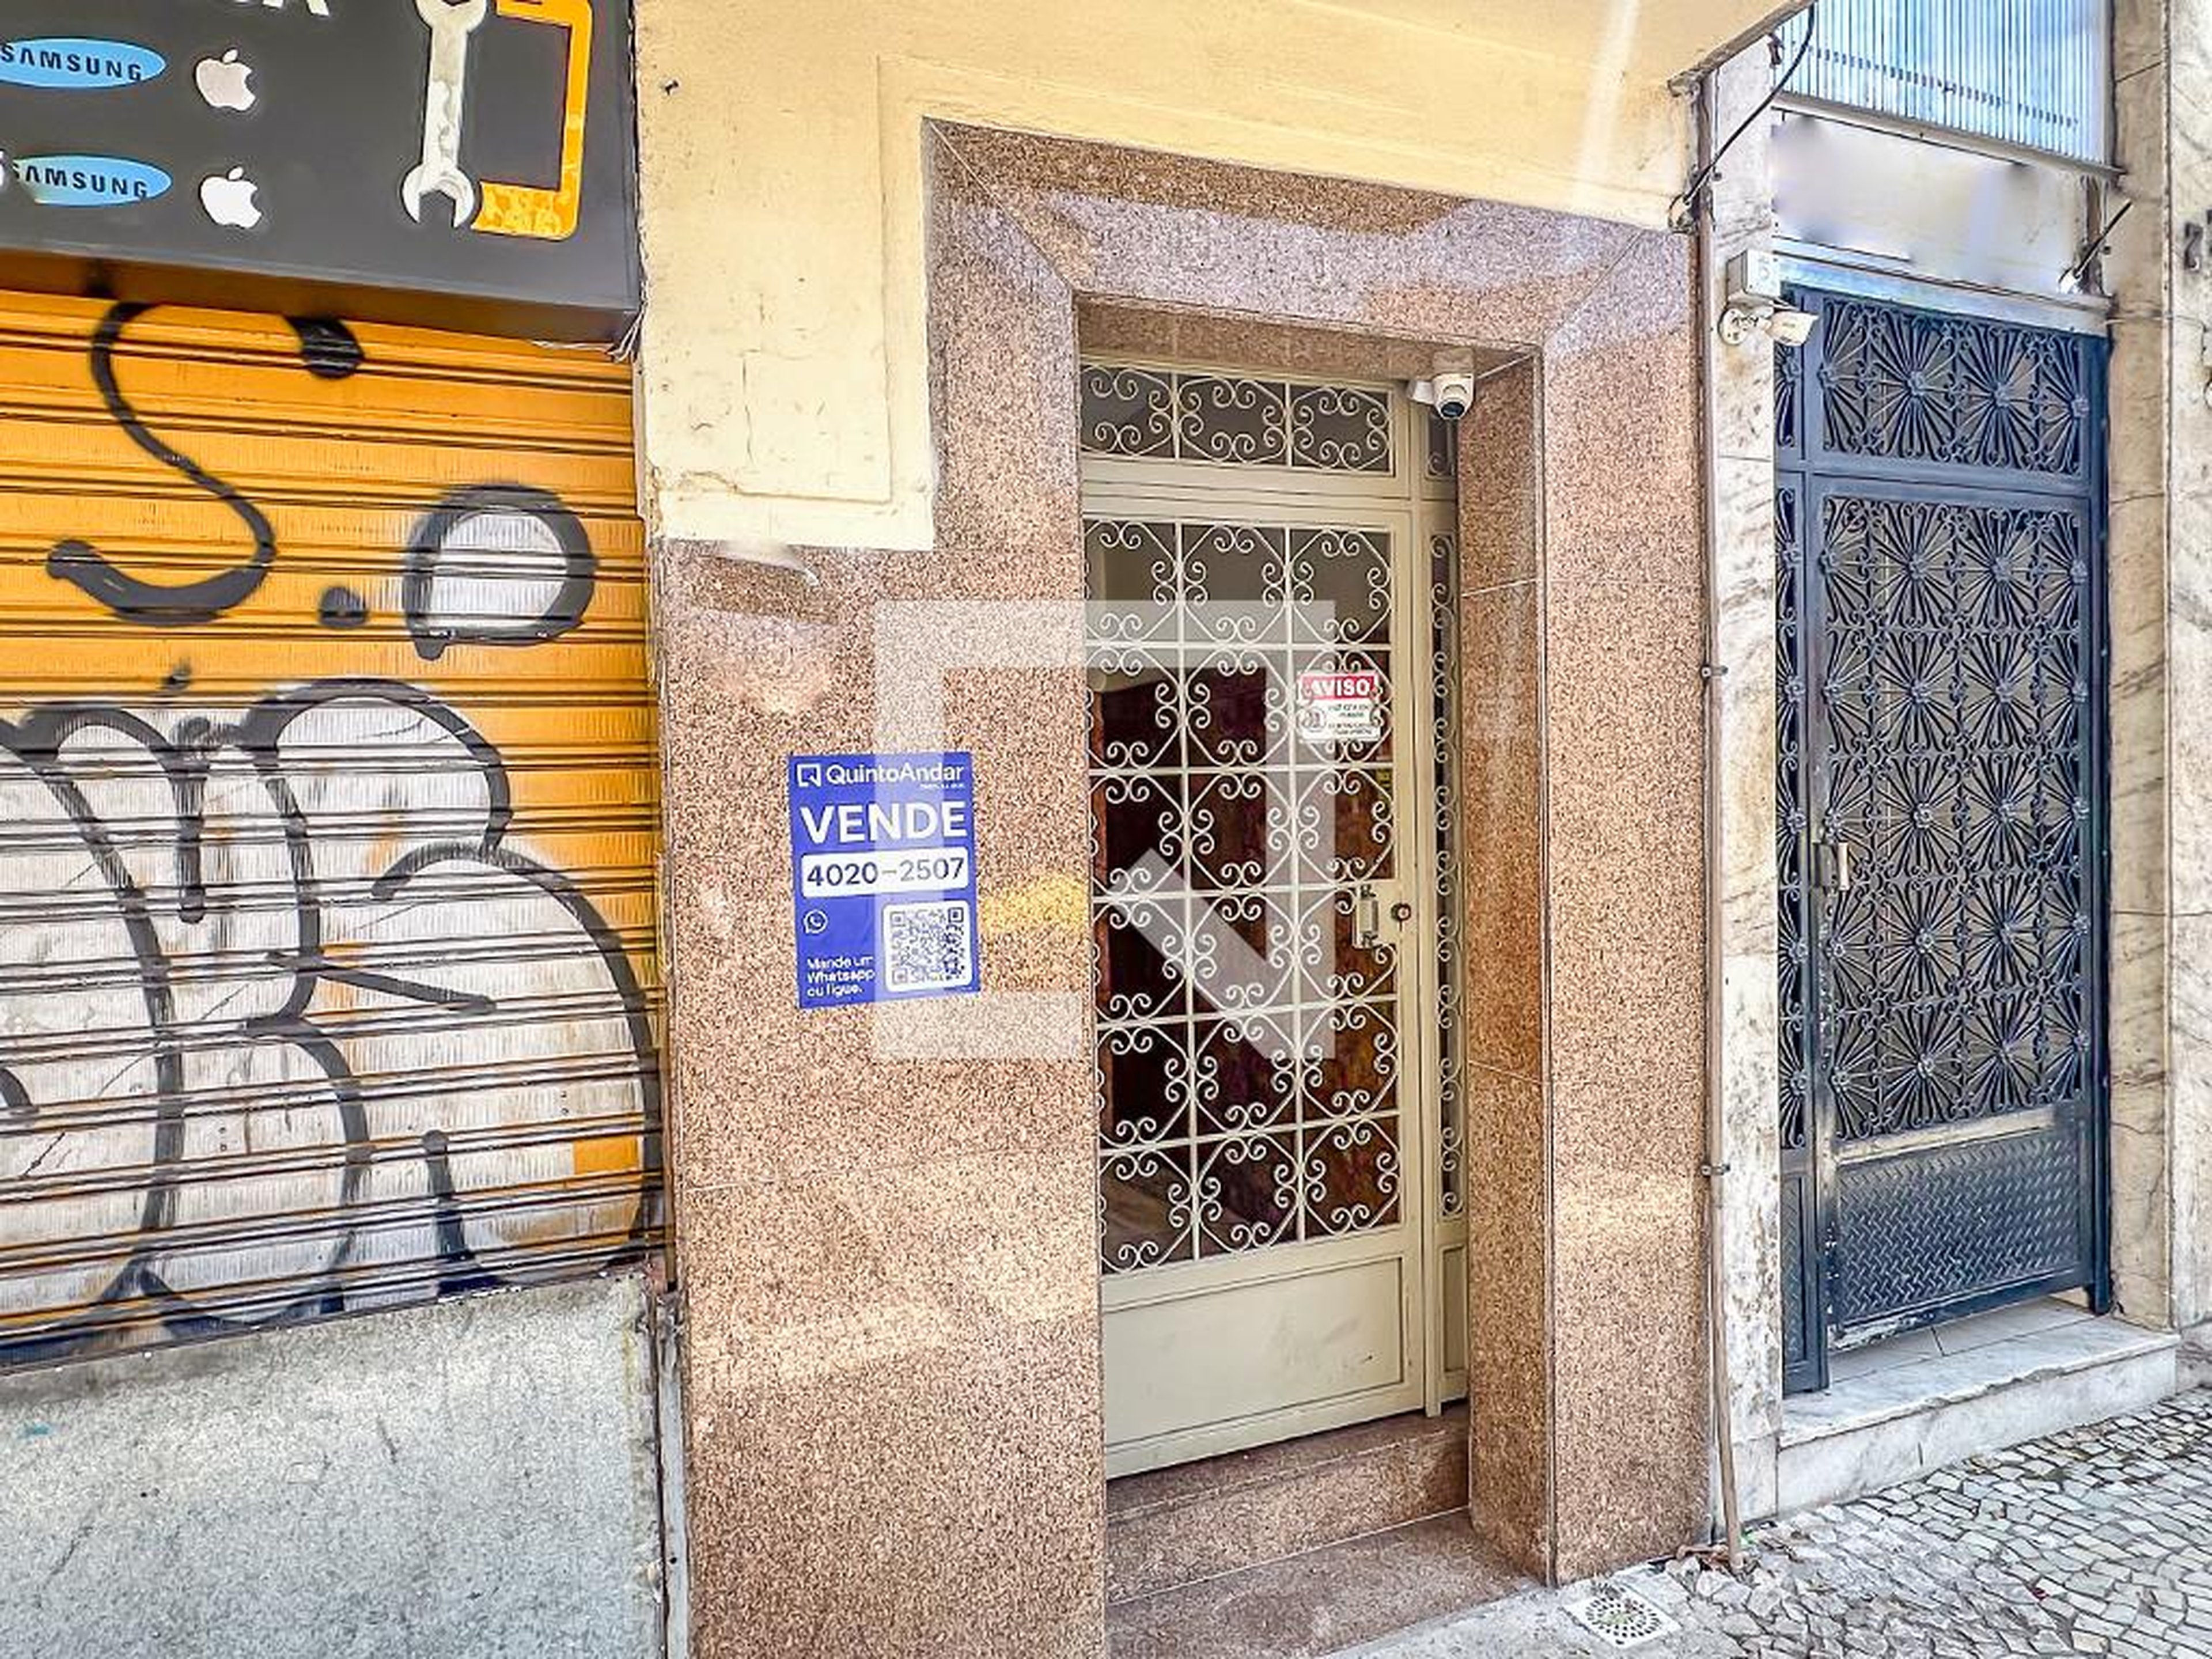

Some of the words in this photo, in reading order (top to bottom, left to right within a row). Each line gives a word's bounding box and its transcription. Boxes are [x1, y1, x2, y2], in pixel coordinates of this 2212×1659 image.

[0, 44, 141, 81] SAMSUNG
[1310, 678, 1370, 697] AVISO
[826, 762, 964, 785] QuintoAndar
[800, 801, 968, 844] VENDE
[806, 857, 965, 887] 4020-2507
[806, 956, 852, 969] Mande
